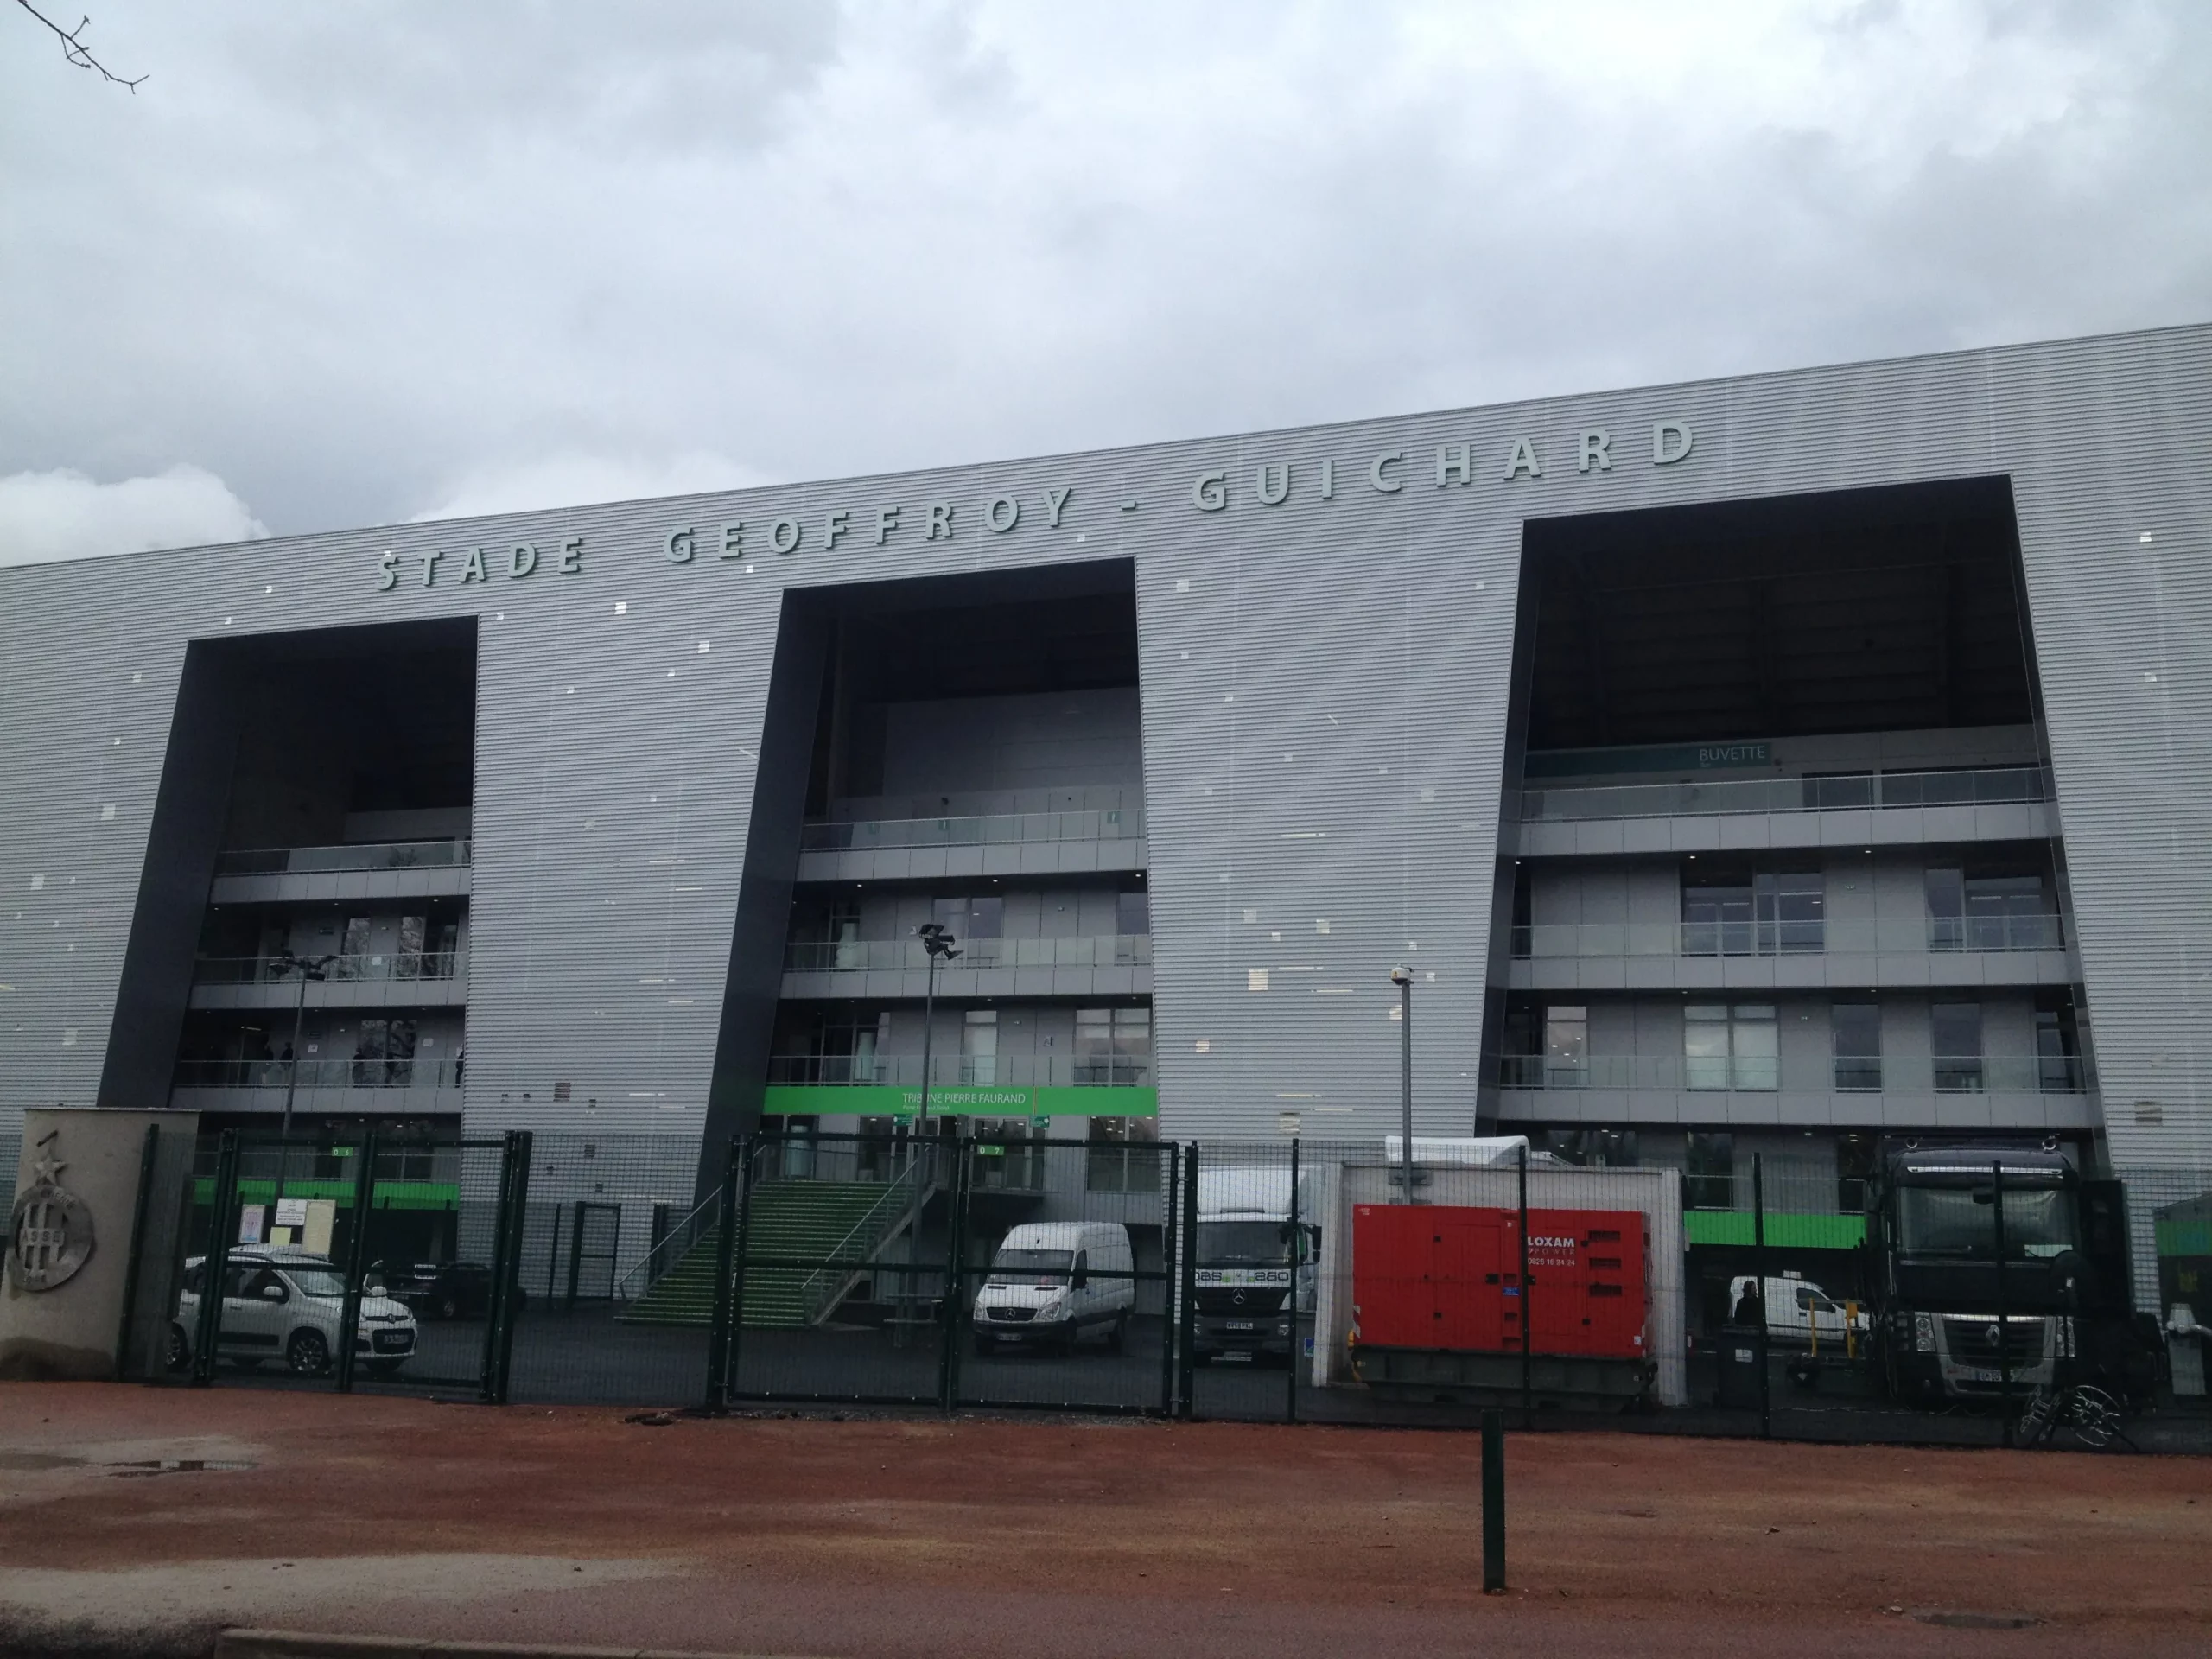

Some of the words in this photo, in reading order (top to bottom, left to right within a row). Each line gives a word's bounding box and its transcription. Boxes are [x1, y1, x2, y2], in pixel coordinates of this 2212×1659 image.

[373, 536, 582, 592] STADE
[662, 486, 1072, 563] GEOFFROY
[1192, 419, 1694, 512] GUICHARD
[1699, 745, 1765, 761] BUVETTE
[902, 1093, 942, 1103] TRIBNE
[944, 1093, 976, 1103] PIERRE
[978, 1093, 1026, 1104] FAURAND
[20, 1230, 61, 1243] ASSE
[1527, 1236, 1575, 1248] LOXAM
